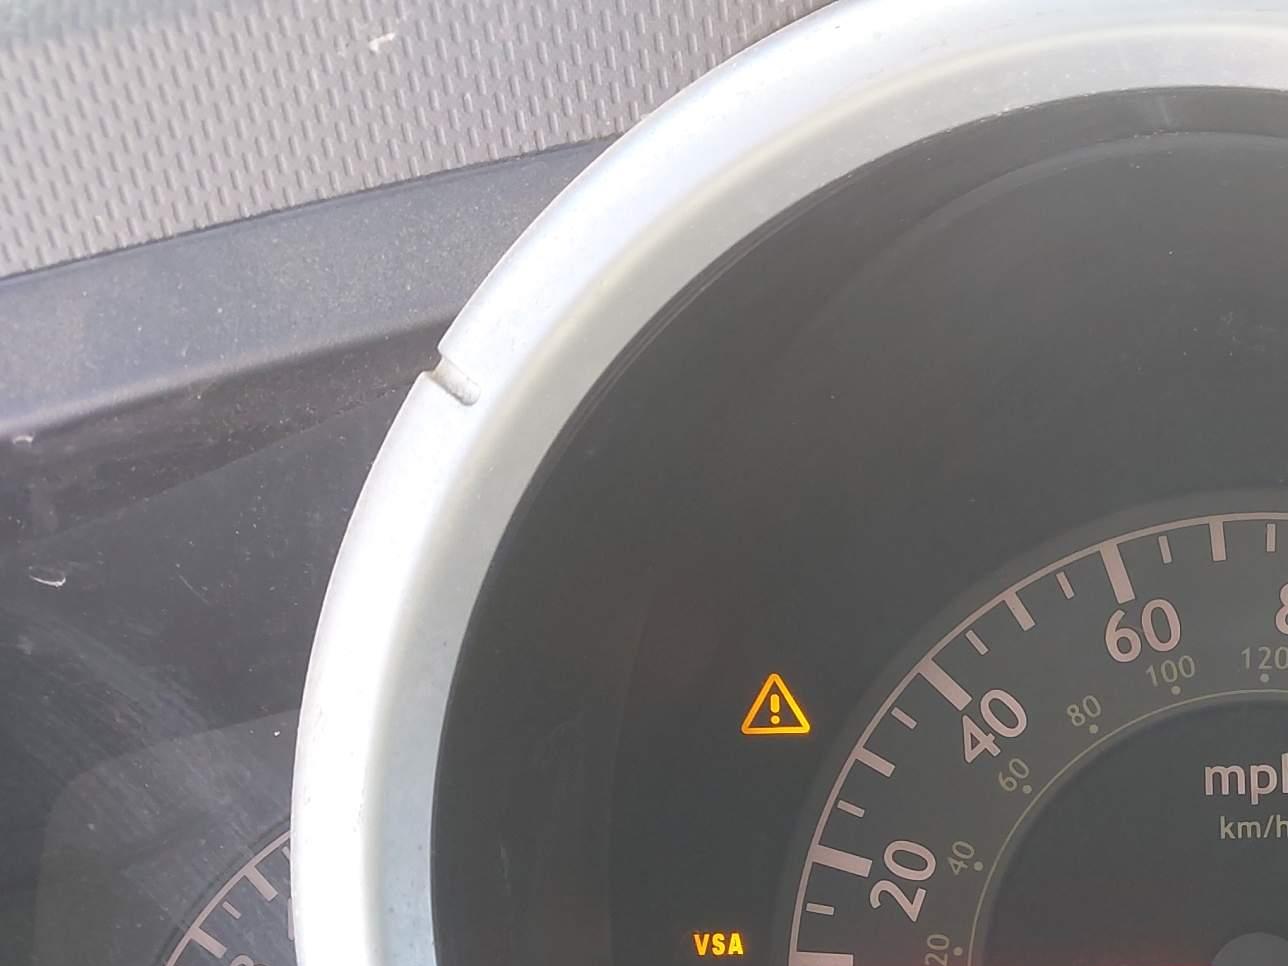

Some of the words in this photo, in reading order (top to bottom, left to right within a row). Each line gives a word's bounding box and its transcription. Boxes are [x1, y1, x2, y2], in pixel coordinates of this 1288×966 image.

[1105, 599, 1182, 663] 60
[1145, 654, 1196, 688] 100
[961, 689, 1028, 764] 40
[1066, 694, 1102, 728] 80
[998, 758, 1031, 794] 60
[947, 840, 975, 876] 40
[869, 840, 936, 922] 20
[693, 932, 744, 956] VSA
[925, 933, 950, 966] 20
